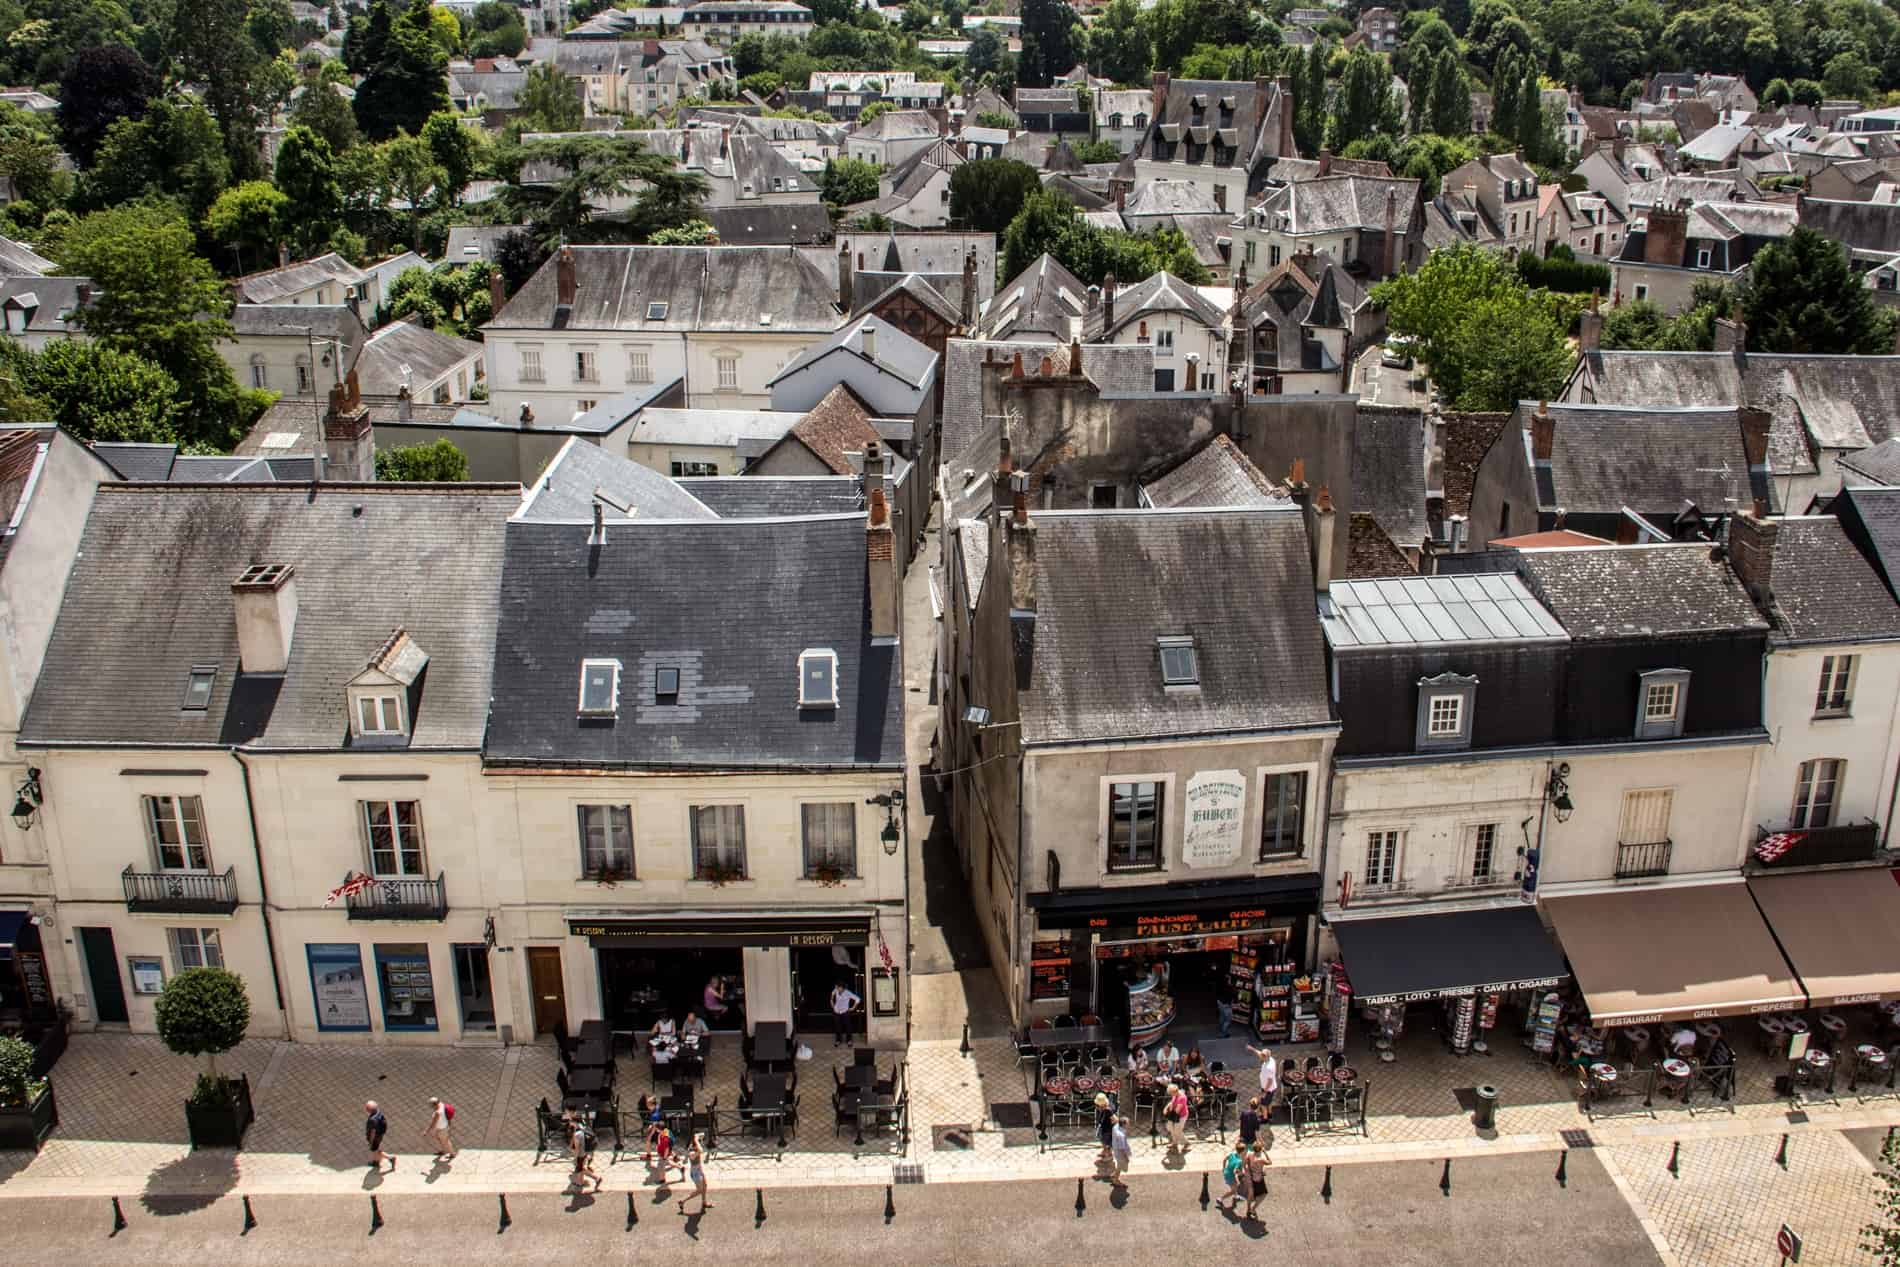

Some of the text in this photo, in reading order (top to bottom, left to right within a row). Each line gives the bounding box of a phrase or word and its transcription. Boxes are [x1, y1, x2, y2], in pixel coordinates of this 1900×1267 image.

[1366, 996, 1396, 1005] TABAC
[1405, 992, 1431, 1001] LOTO
[1439, 987, 1475, 998] PRESSE
[1484, 983, 1507, 993] CAVE
[1518, 978, 1559, 989] CIGARES
[1603, 1014, 1663, 1026] RESTAURANT
[1693, 1009, 1719, 1018] GRILL
